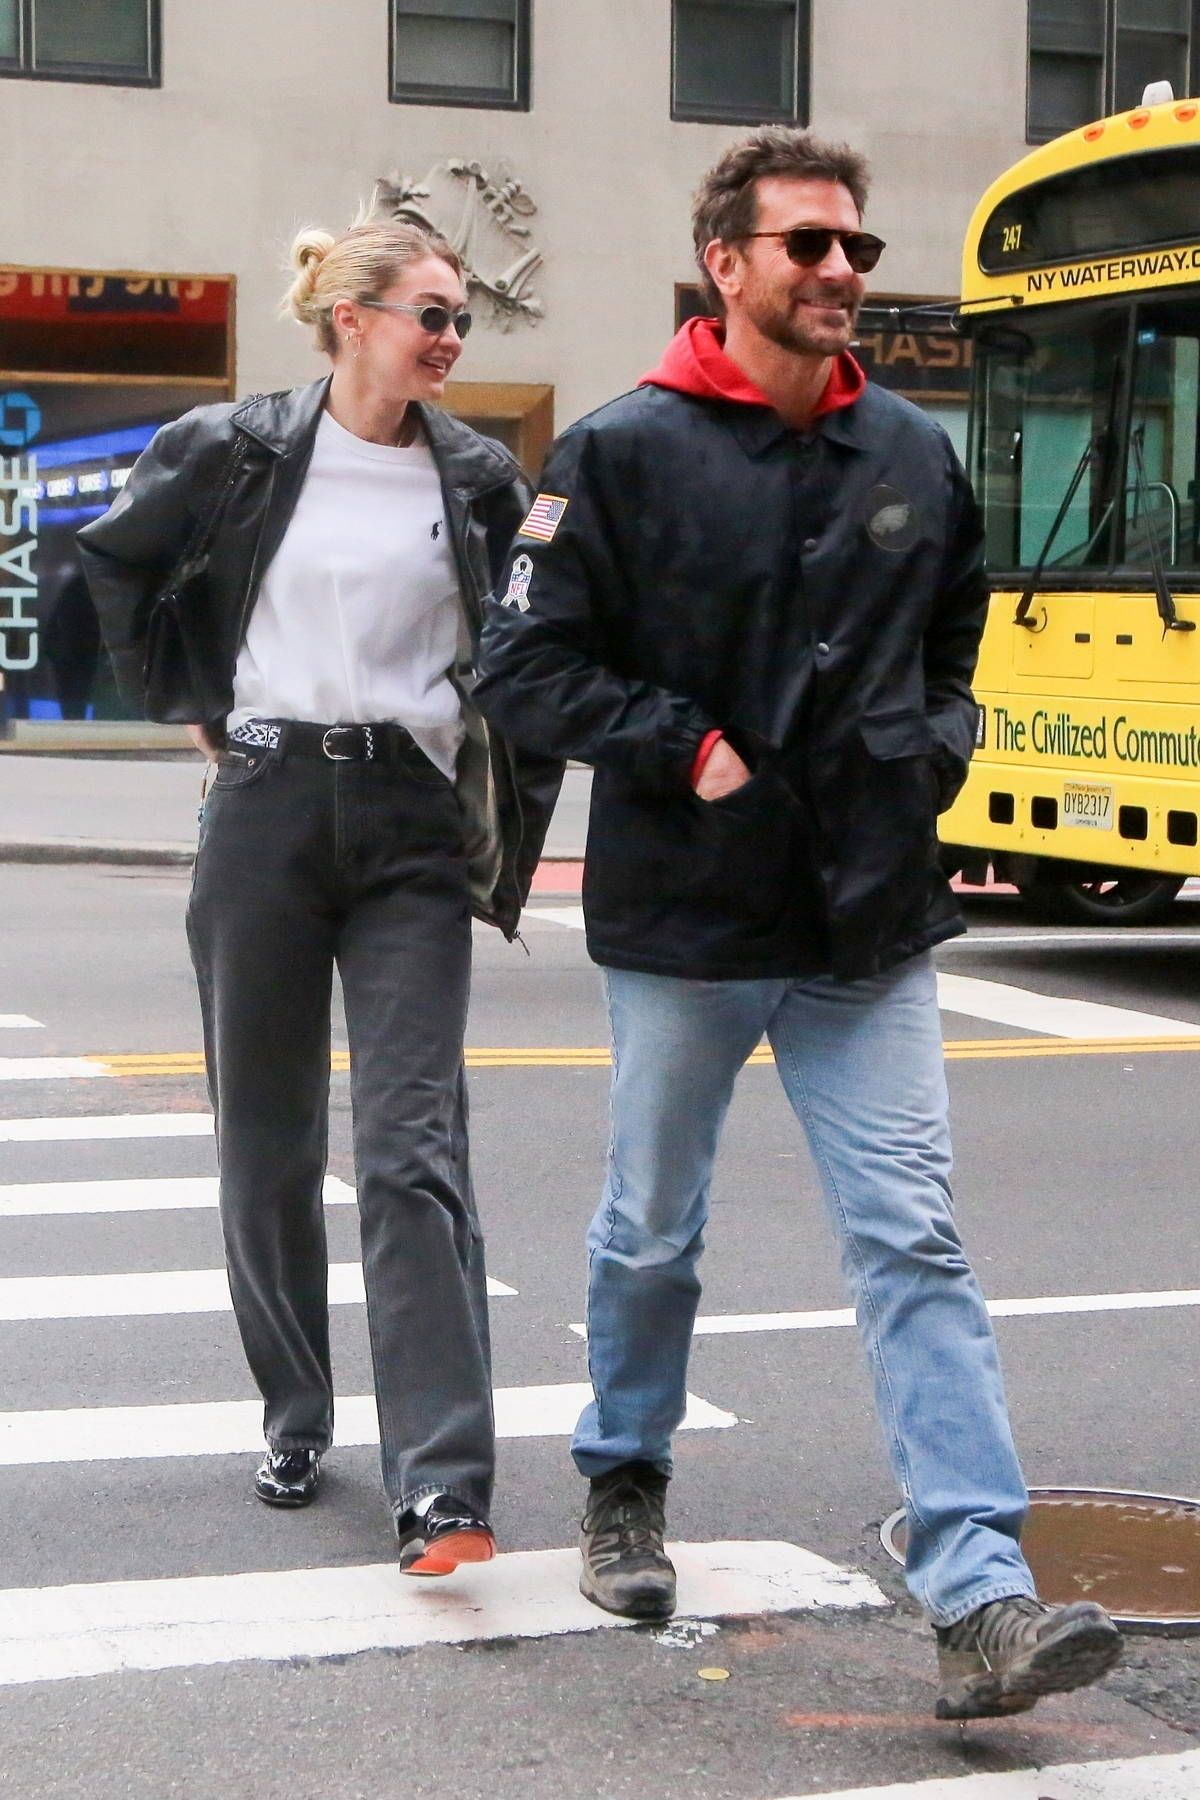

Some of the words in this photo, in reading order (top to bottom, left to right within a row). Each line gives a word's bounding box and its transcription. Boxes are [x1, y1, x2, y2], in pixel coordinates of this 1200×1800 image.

[1002, 224, 1022, 252] 247
[1027, 271, 1058, 292] NY
[0, 454, 38, 670] CHASE
[993, 708, 1026, 752] The
[1032, 710, 1106, 759] Civilized
